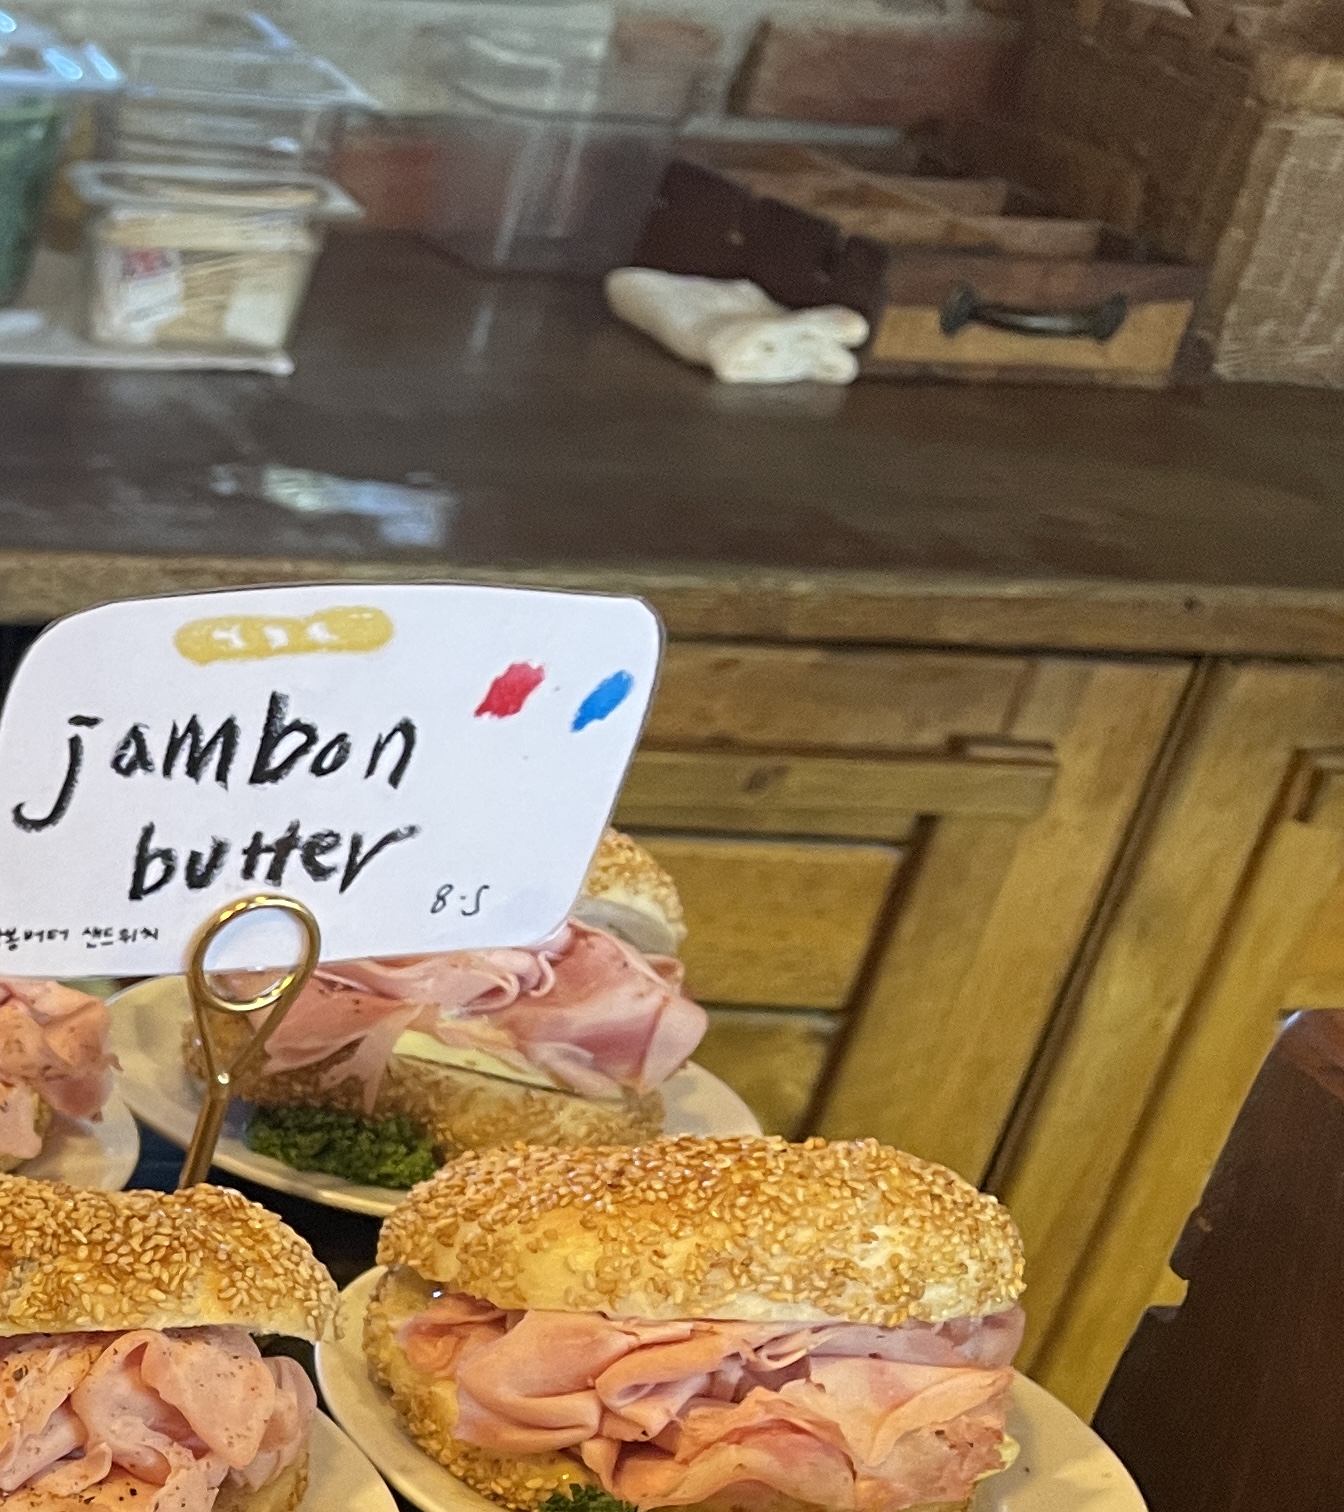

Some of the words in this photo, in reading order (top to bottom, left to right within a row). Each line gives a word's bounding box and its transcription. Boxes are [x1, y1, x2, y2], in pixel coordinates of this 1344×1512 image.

[12, 691, 419, 833] jambon
[128, 818, 420, 900] butter
[82, 927, 159, 949] 샌드위치
